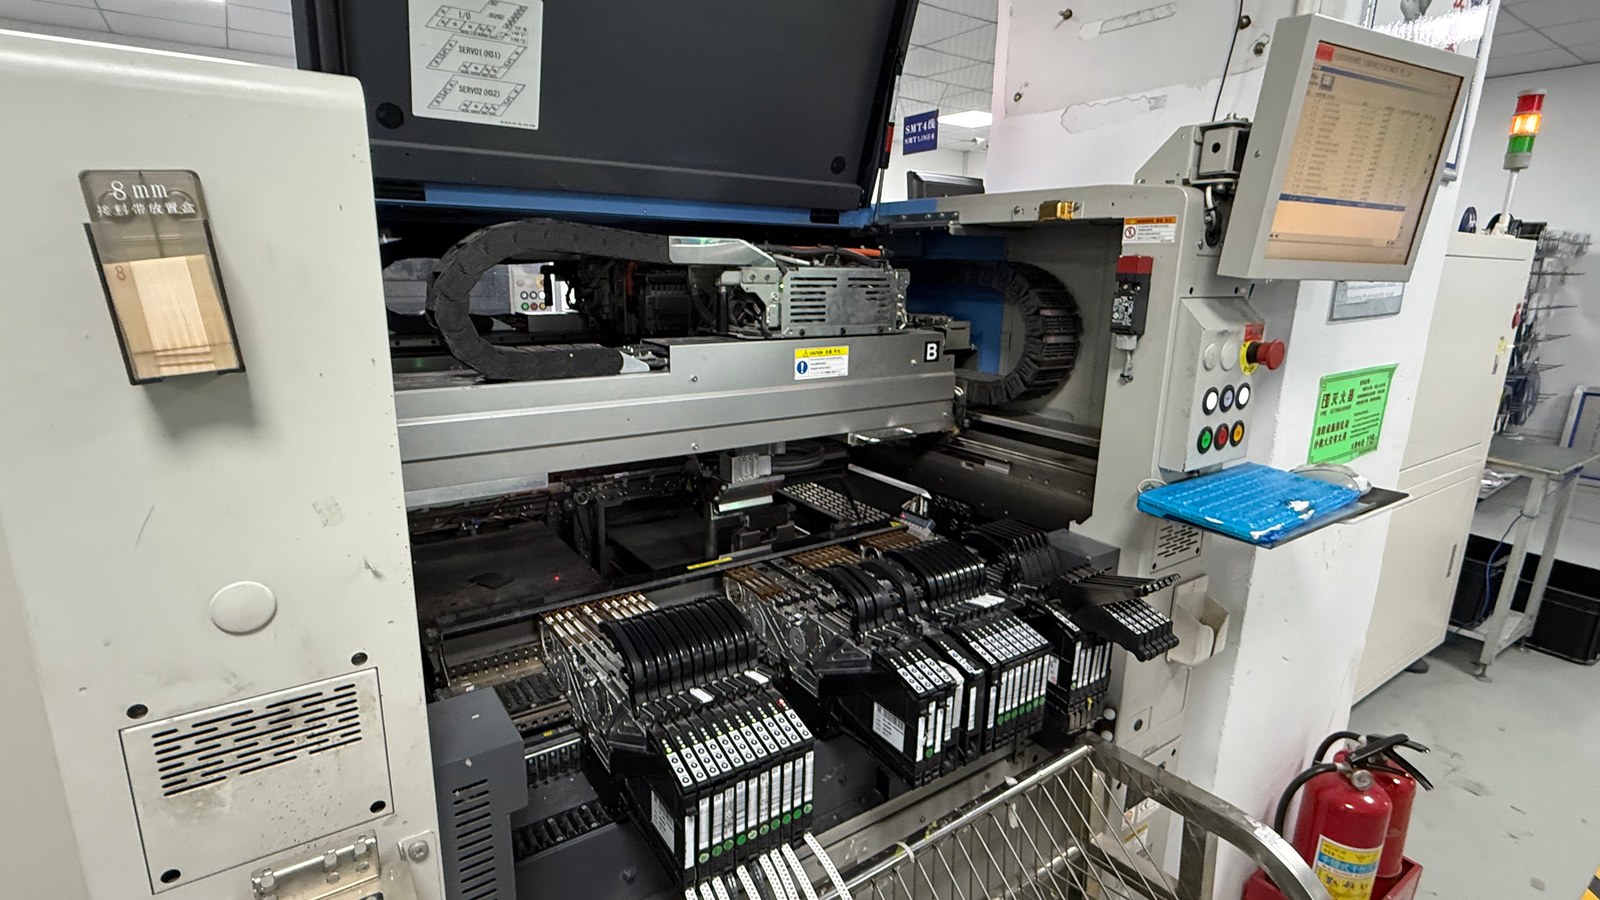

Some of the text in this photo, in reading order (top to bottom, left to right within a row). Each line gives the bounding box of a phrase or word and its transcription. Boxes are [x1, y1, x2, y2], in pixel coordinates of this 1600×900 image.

[110, 180, 169, 201] 8 mm
[114, 265, 126, 281] 8
[926, 342, 938, 361] B
